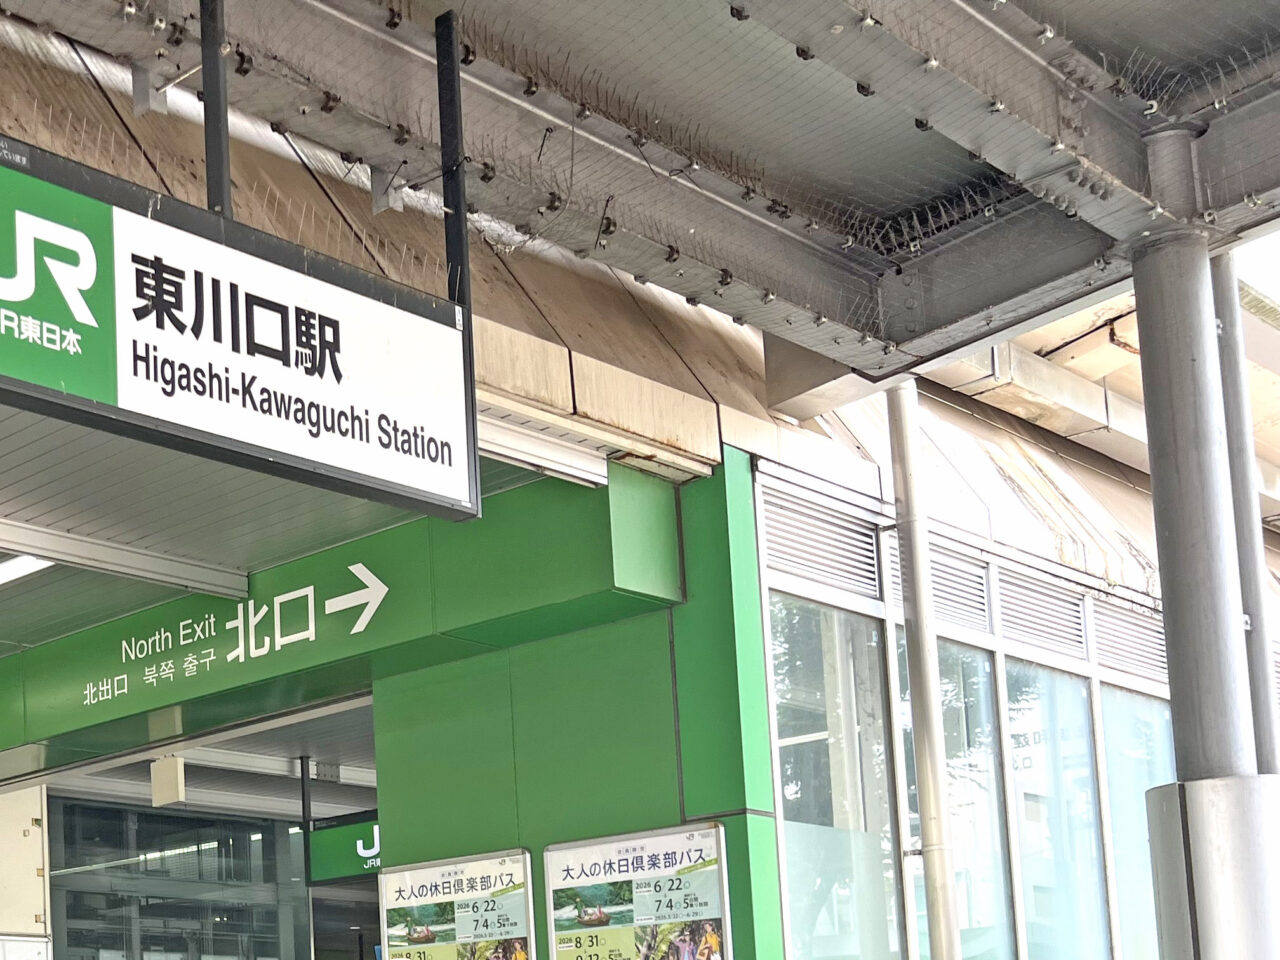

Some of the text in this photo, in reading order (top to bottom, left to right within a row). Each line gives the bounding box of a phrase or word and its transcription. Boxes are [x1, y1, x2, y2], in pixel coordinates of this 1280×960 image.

[131, 253, 342, 385] 東川口駅
[133, 340, 453, 467] Higashi-Kawaguchi Station
[121, 614, 216, 663] North Exit
[225, 585, 317, 663] 北口
[83, 648, 217, 706] 北出口 북쪽 출구
[395, 873, 516, 901] 大人の休日倶楽部パス
[562, 848, 706, 881] 大人の休日倶楽部パス
